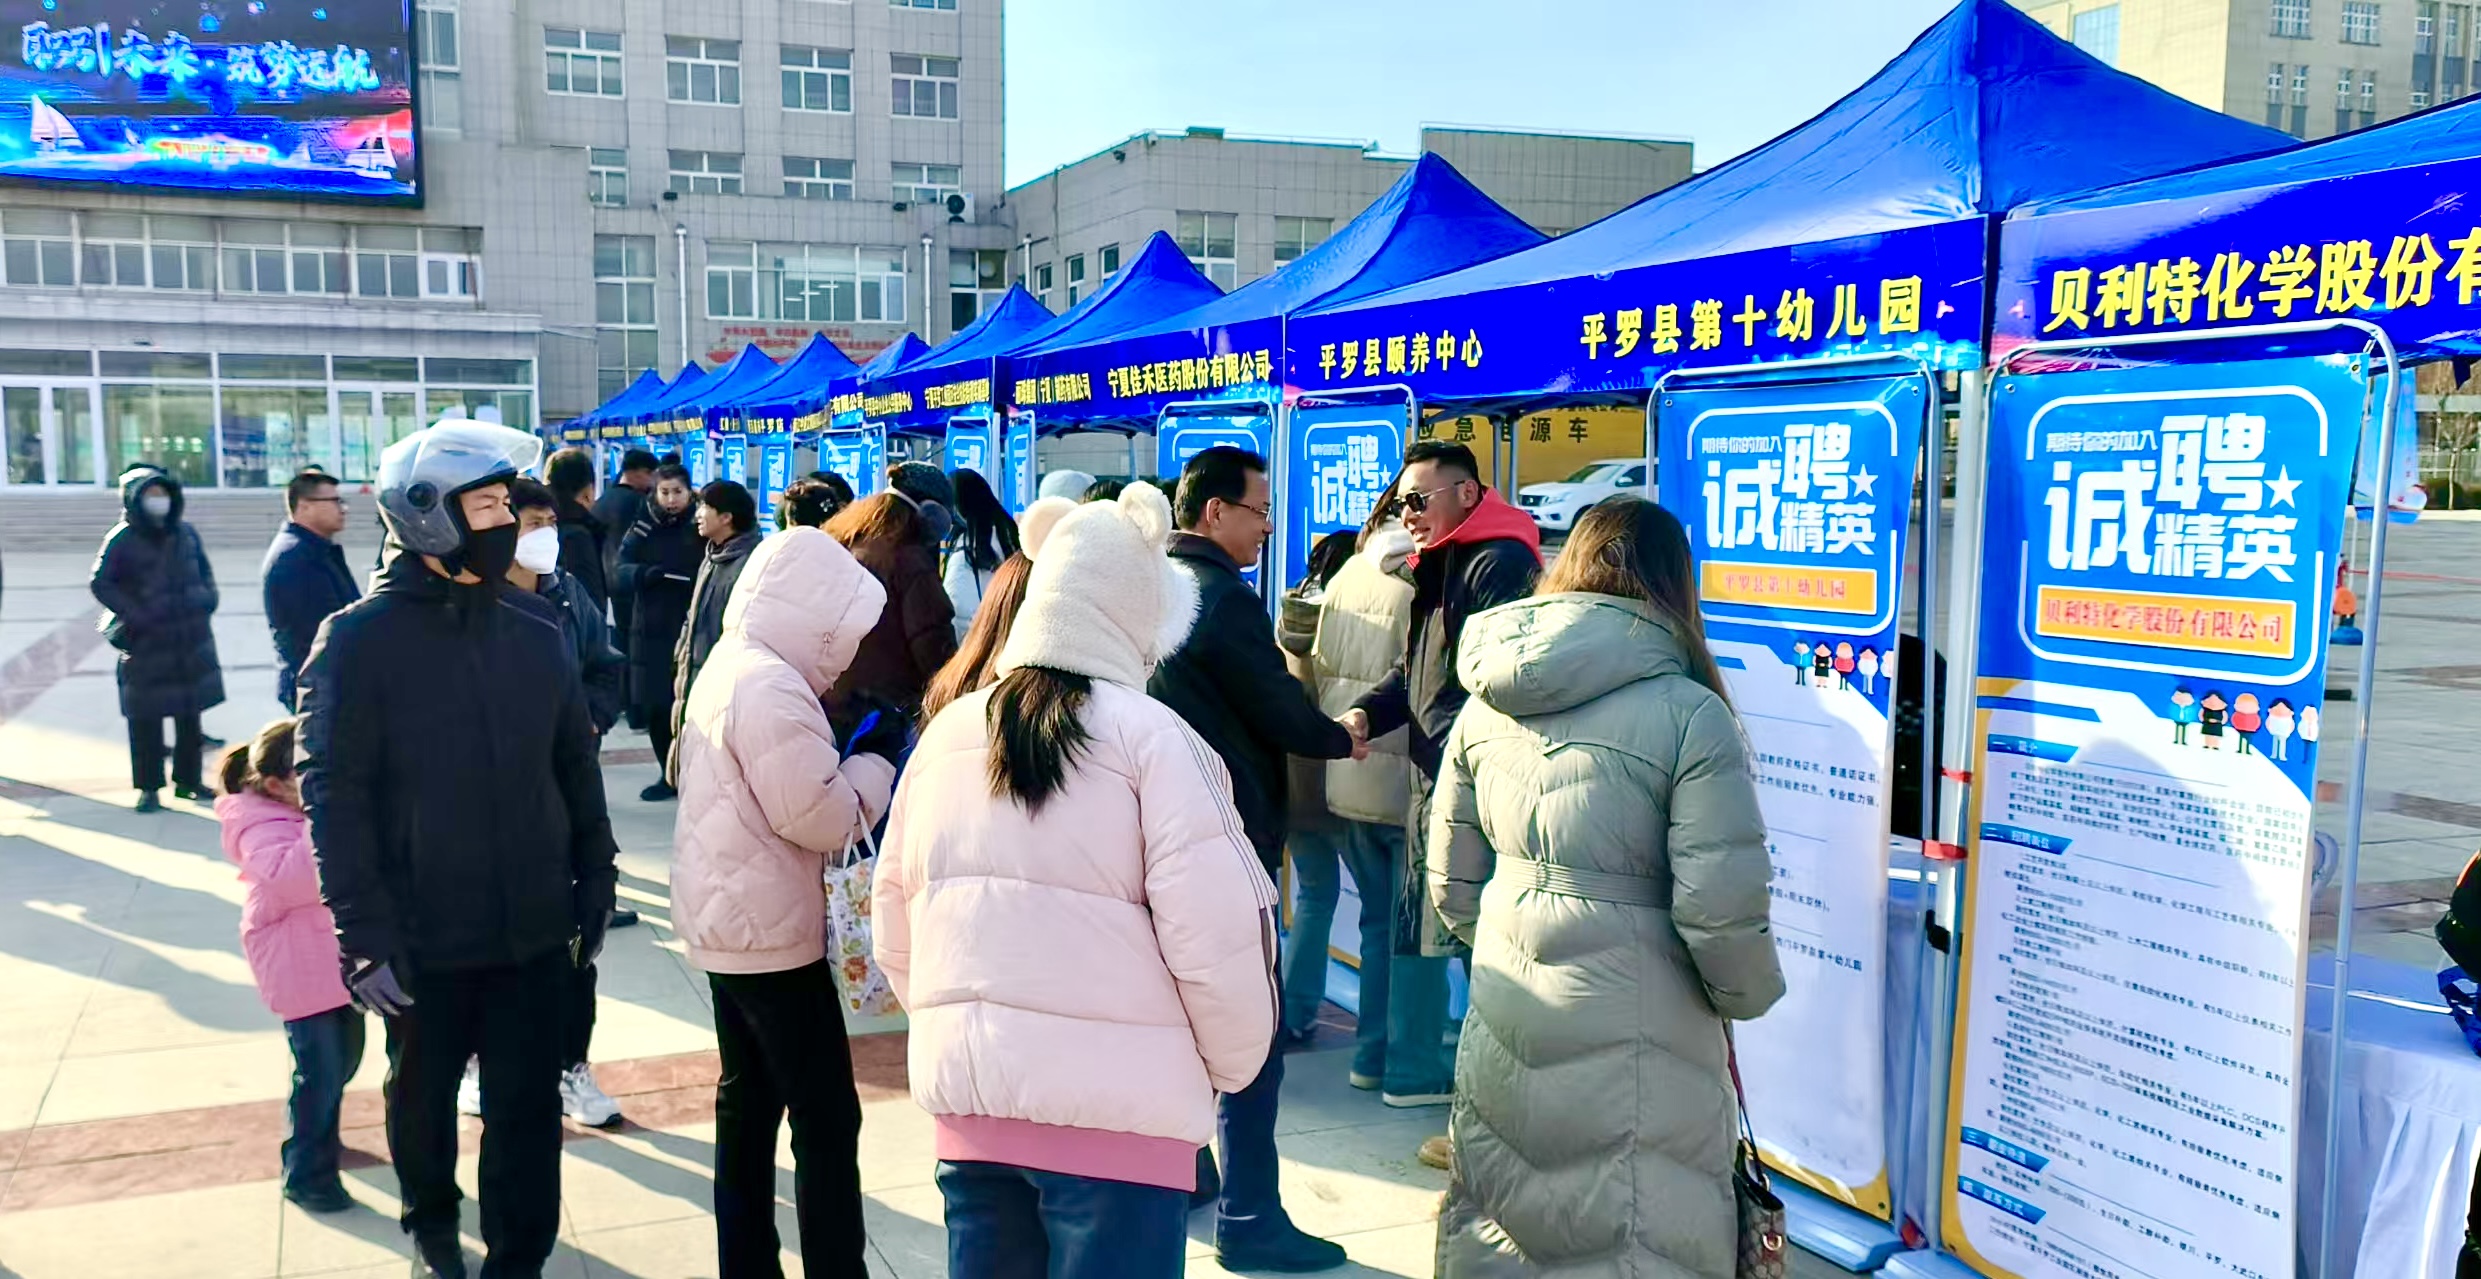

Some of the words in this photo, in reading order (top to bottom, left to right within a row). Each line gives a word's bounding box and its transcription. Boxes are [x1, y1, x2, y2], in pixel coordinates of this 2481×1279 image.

[2043, 227, 2481, 332] 贝利特化学股份有
[1581, 275, 1923, 361] 平罗县第十幼儿园
[1107, 348, 1271, 399] 宁夏佳禾医药股份有限公司
[1318, 328, 1484, 380] 平罗县颐养中心
[1779, 501, 1877, 556] 精英
[2153, 513, 2298, 582] 精英
[2043, 597, 2282, 643] 贝利特化学股份有限公司
